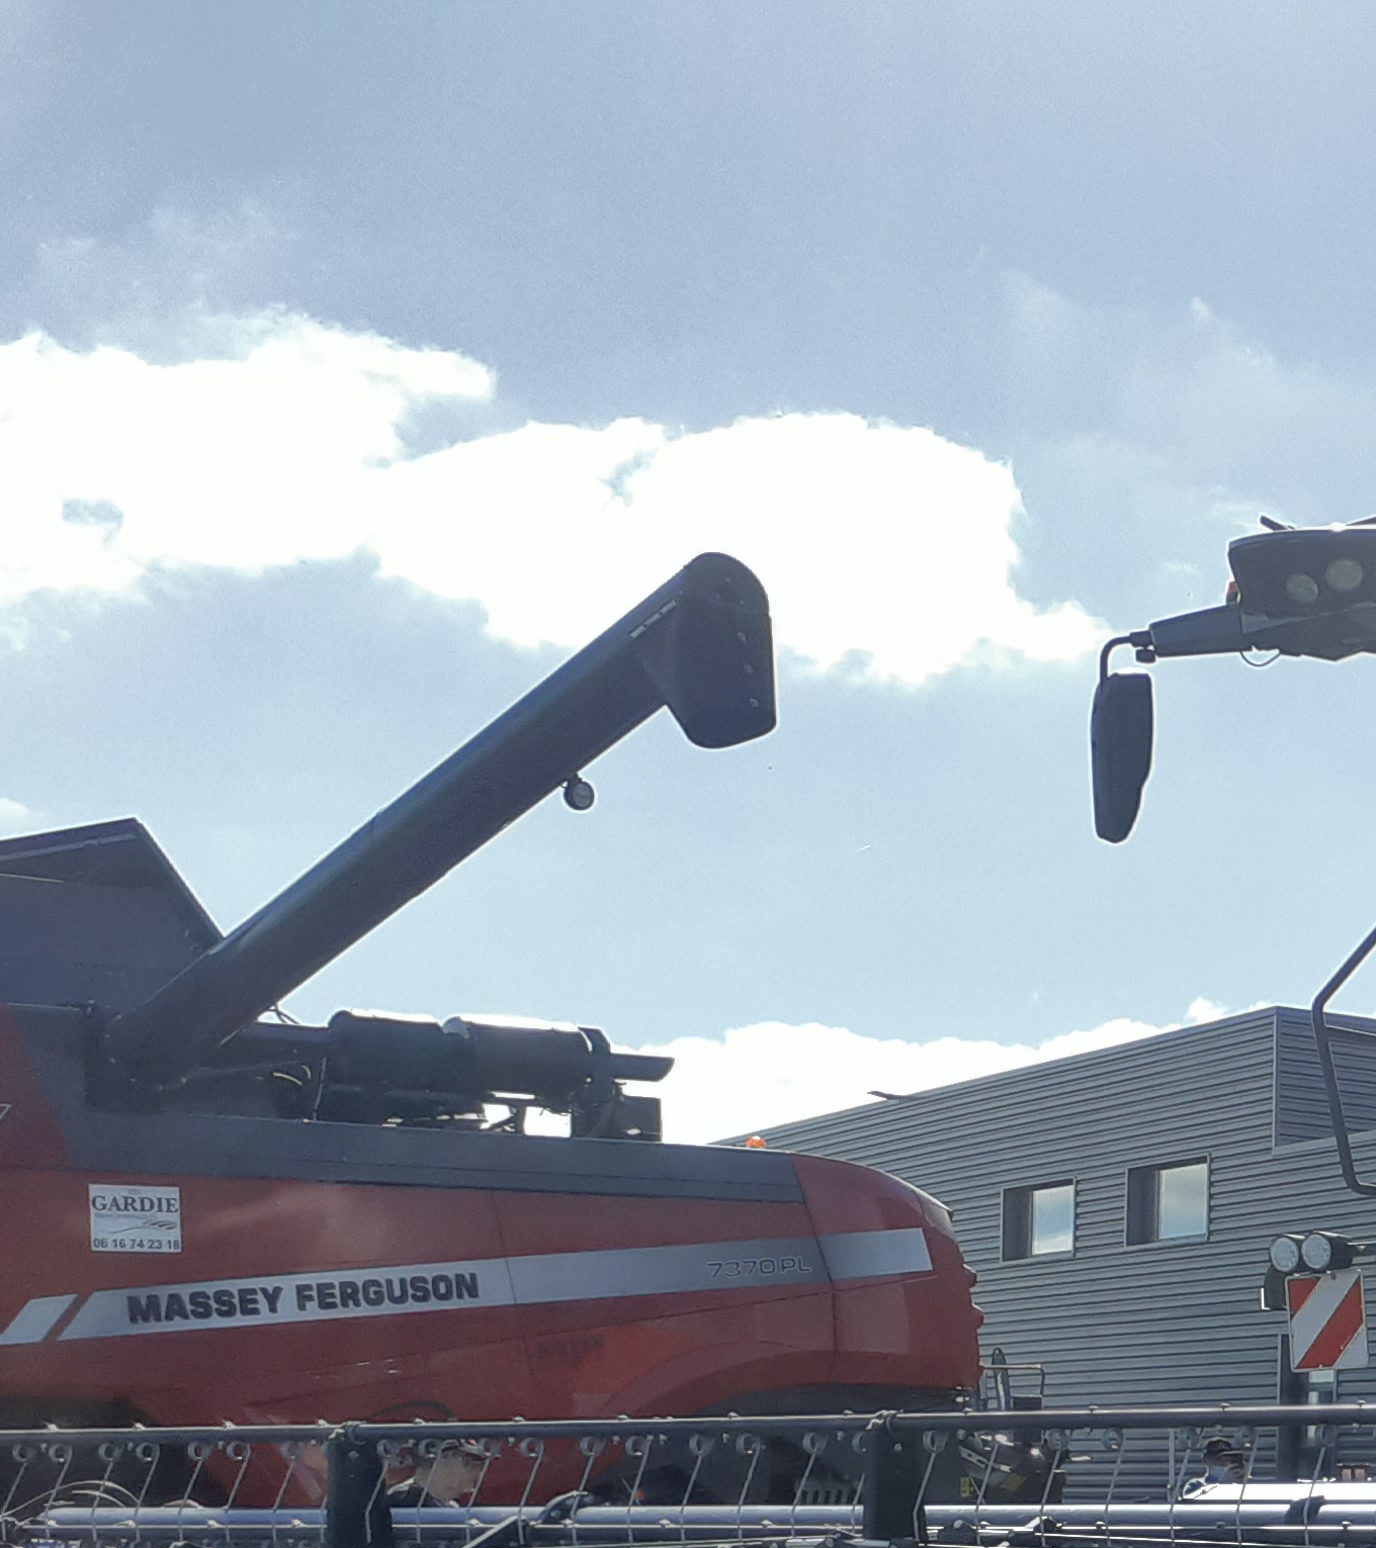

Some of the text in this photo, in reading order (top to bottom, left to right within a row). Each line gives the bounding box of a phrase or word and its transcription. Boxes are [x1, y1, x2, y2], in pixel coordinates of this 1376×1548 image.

[92, 1195, 178, 1213] GARDIE
[148, 1239, 162, 1250] 23
[127, 1271, 480, 1325] MASSEY FERGUSON
